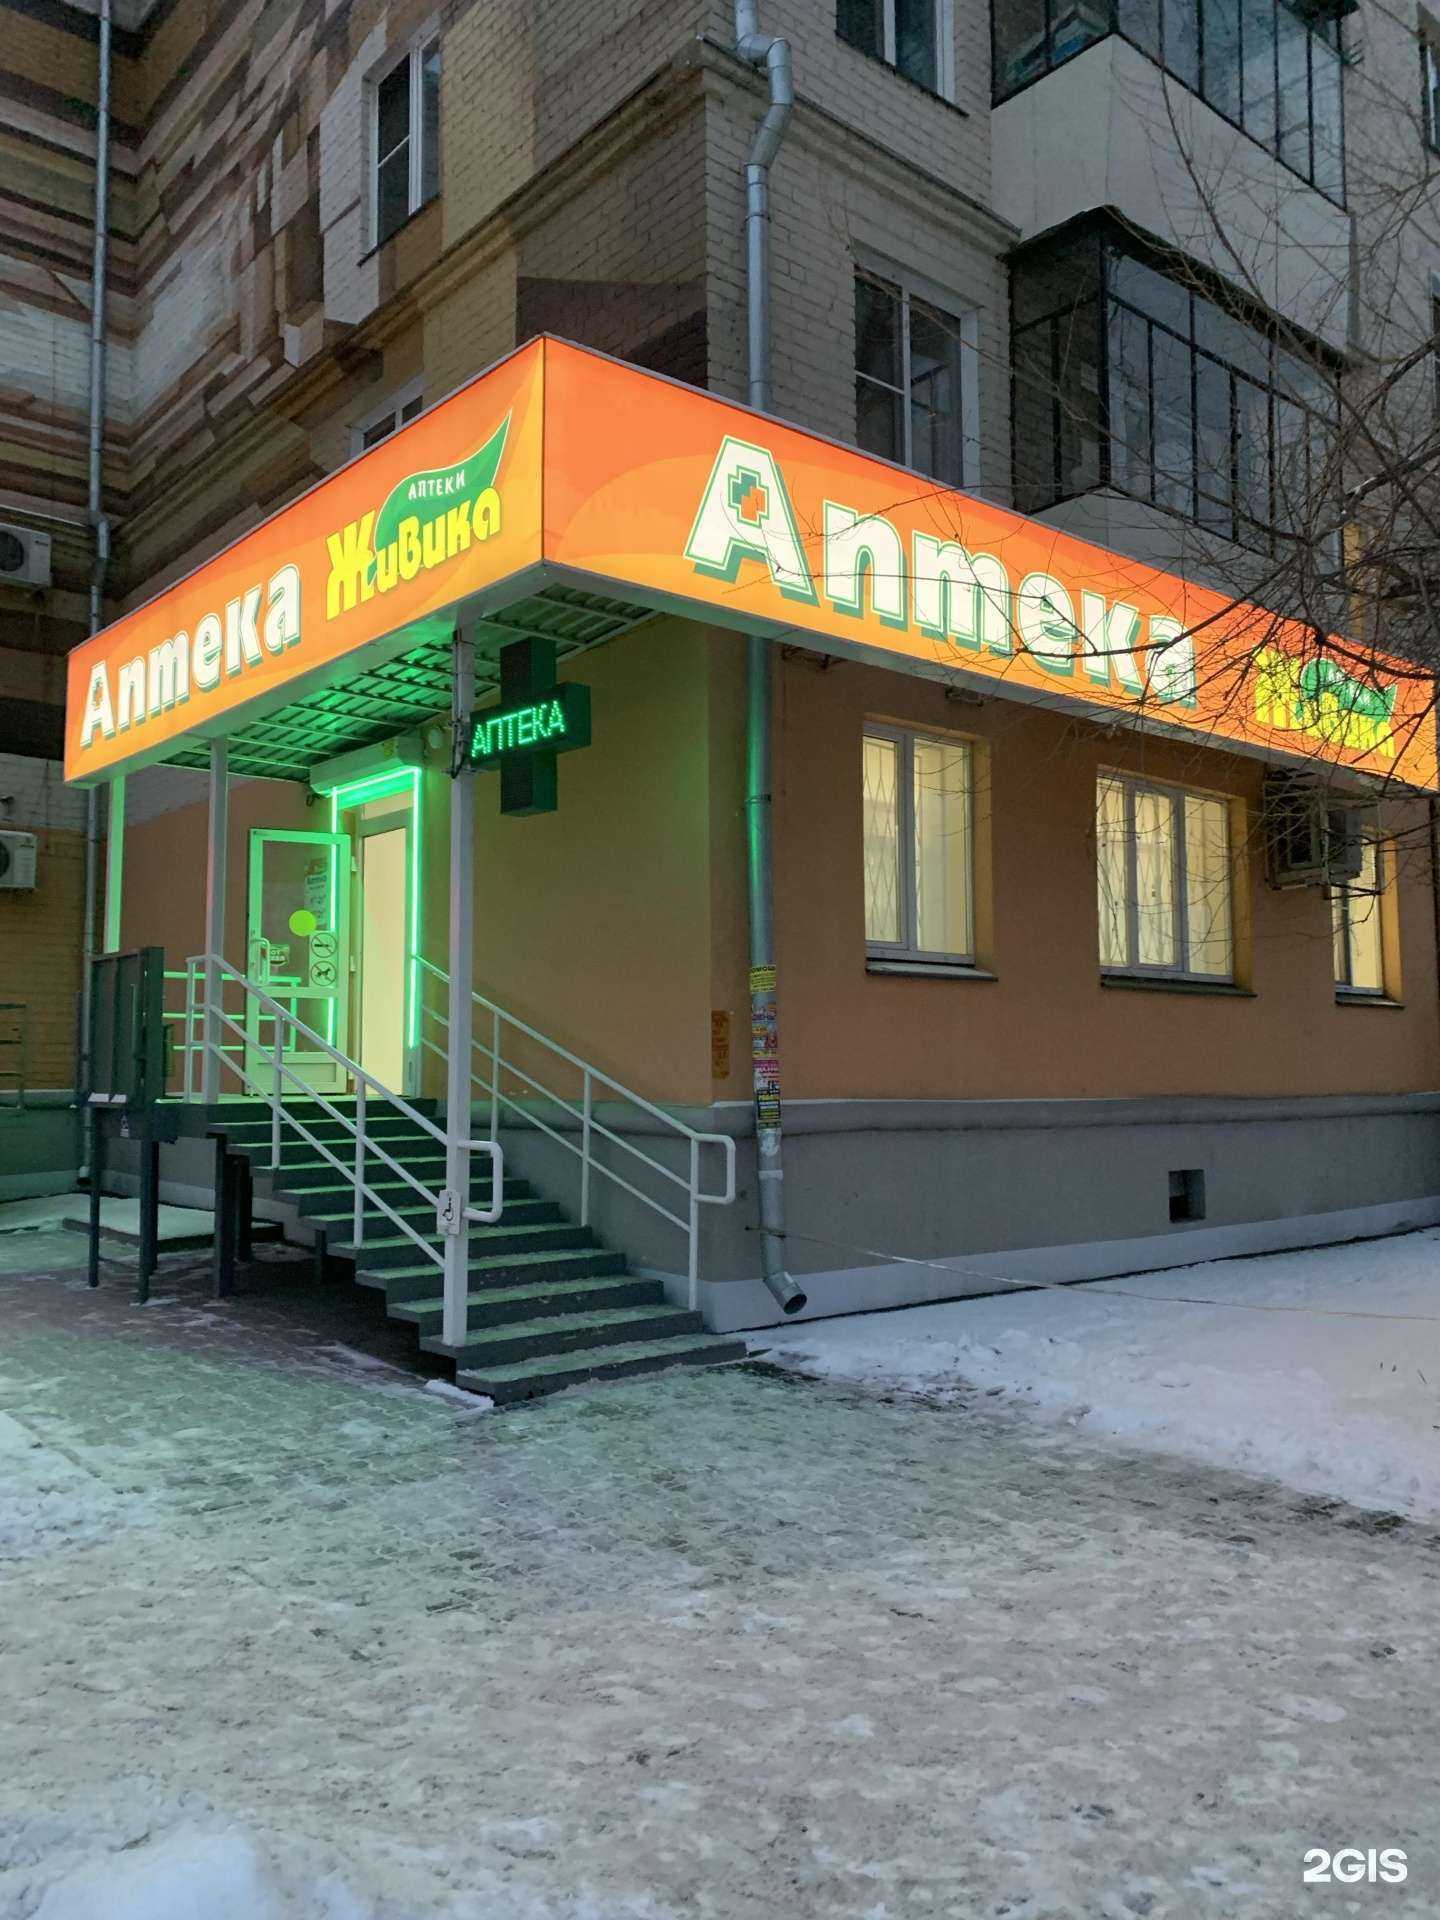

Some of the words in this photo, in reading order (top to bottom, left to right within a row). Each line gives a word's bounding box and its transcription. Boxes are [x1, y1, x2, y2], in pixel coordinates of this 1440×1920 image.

[407, 469, 466, 501] АПТЕКИ
[325, 486, 502, 623] Живика
[683, 434, 1197, 710] Аптека
[79, 562, 301, 748] Аптека
[471, 700, 565, 757] АПТЕКА
